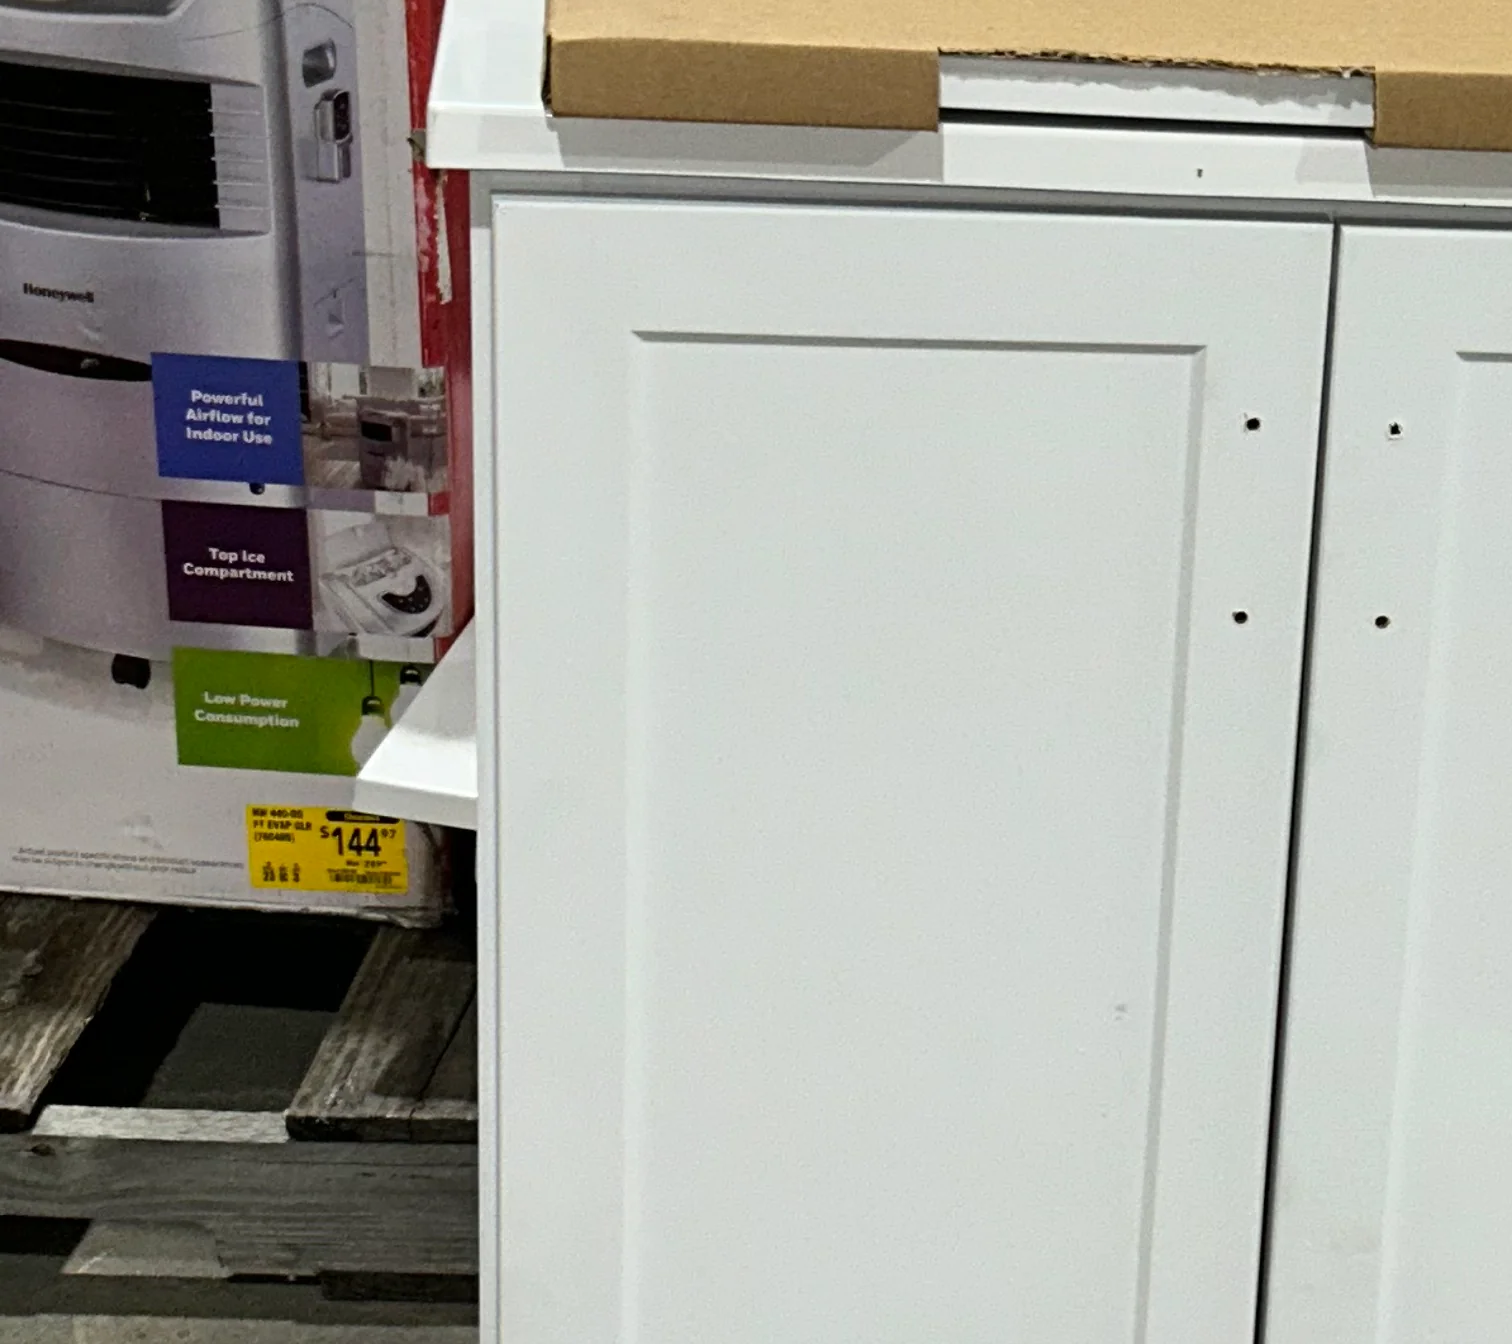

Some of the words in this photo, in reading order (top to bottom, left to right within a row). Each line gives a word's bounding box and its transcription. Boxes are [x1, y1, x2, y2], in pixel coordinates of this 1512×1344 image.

[23, 282, 94, 304] Honeywell
[191, 389, 264, 407] Powerful
[186, 408, 244, 424] Airflow
[246, 411, 271, 426] for
[186, 427, 239, 443] Indoor
[242, 430, 273, 445] Use
[208, 547, 238, 564] Top
[242, 550, 266, 564] Ice
[183, 562, 294, 582] Compartment
[204, 690, 236, 705] Low
[239, 694, 288, 709] Power
[194, 709, 300, 728] Consumption
